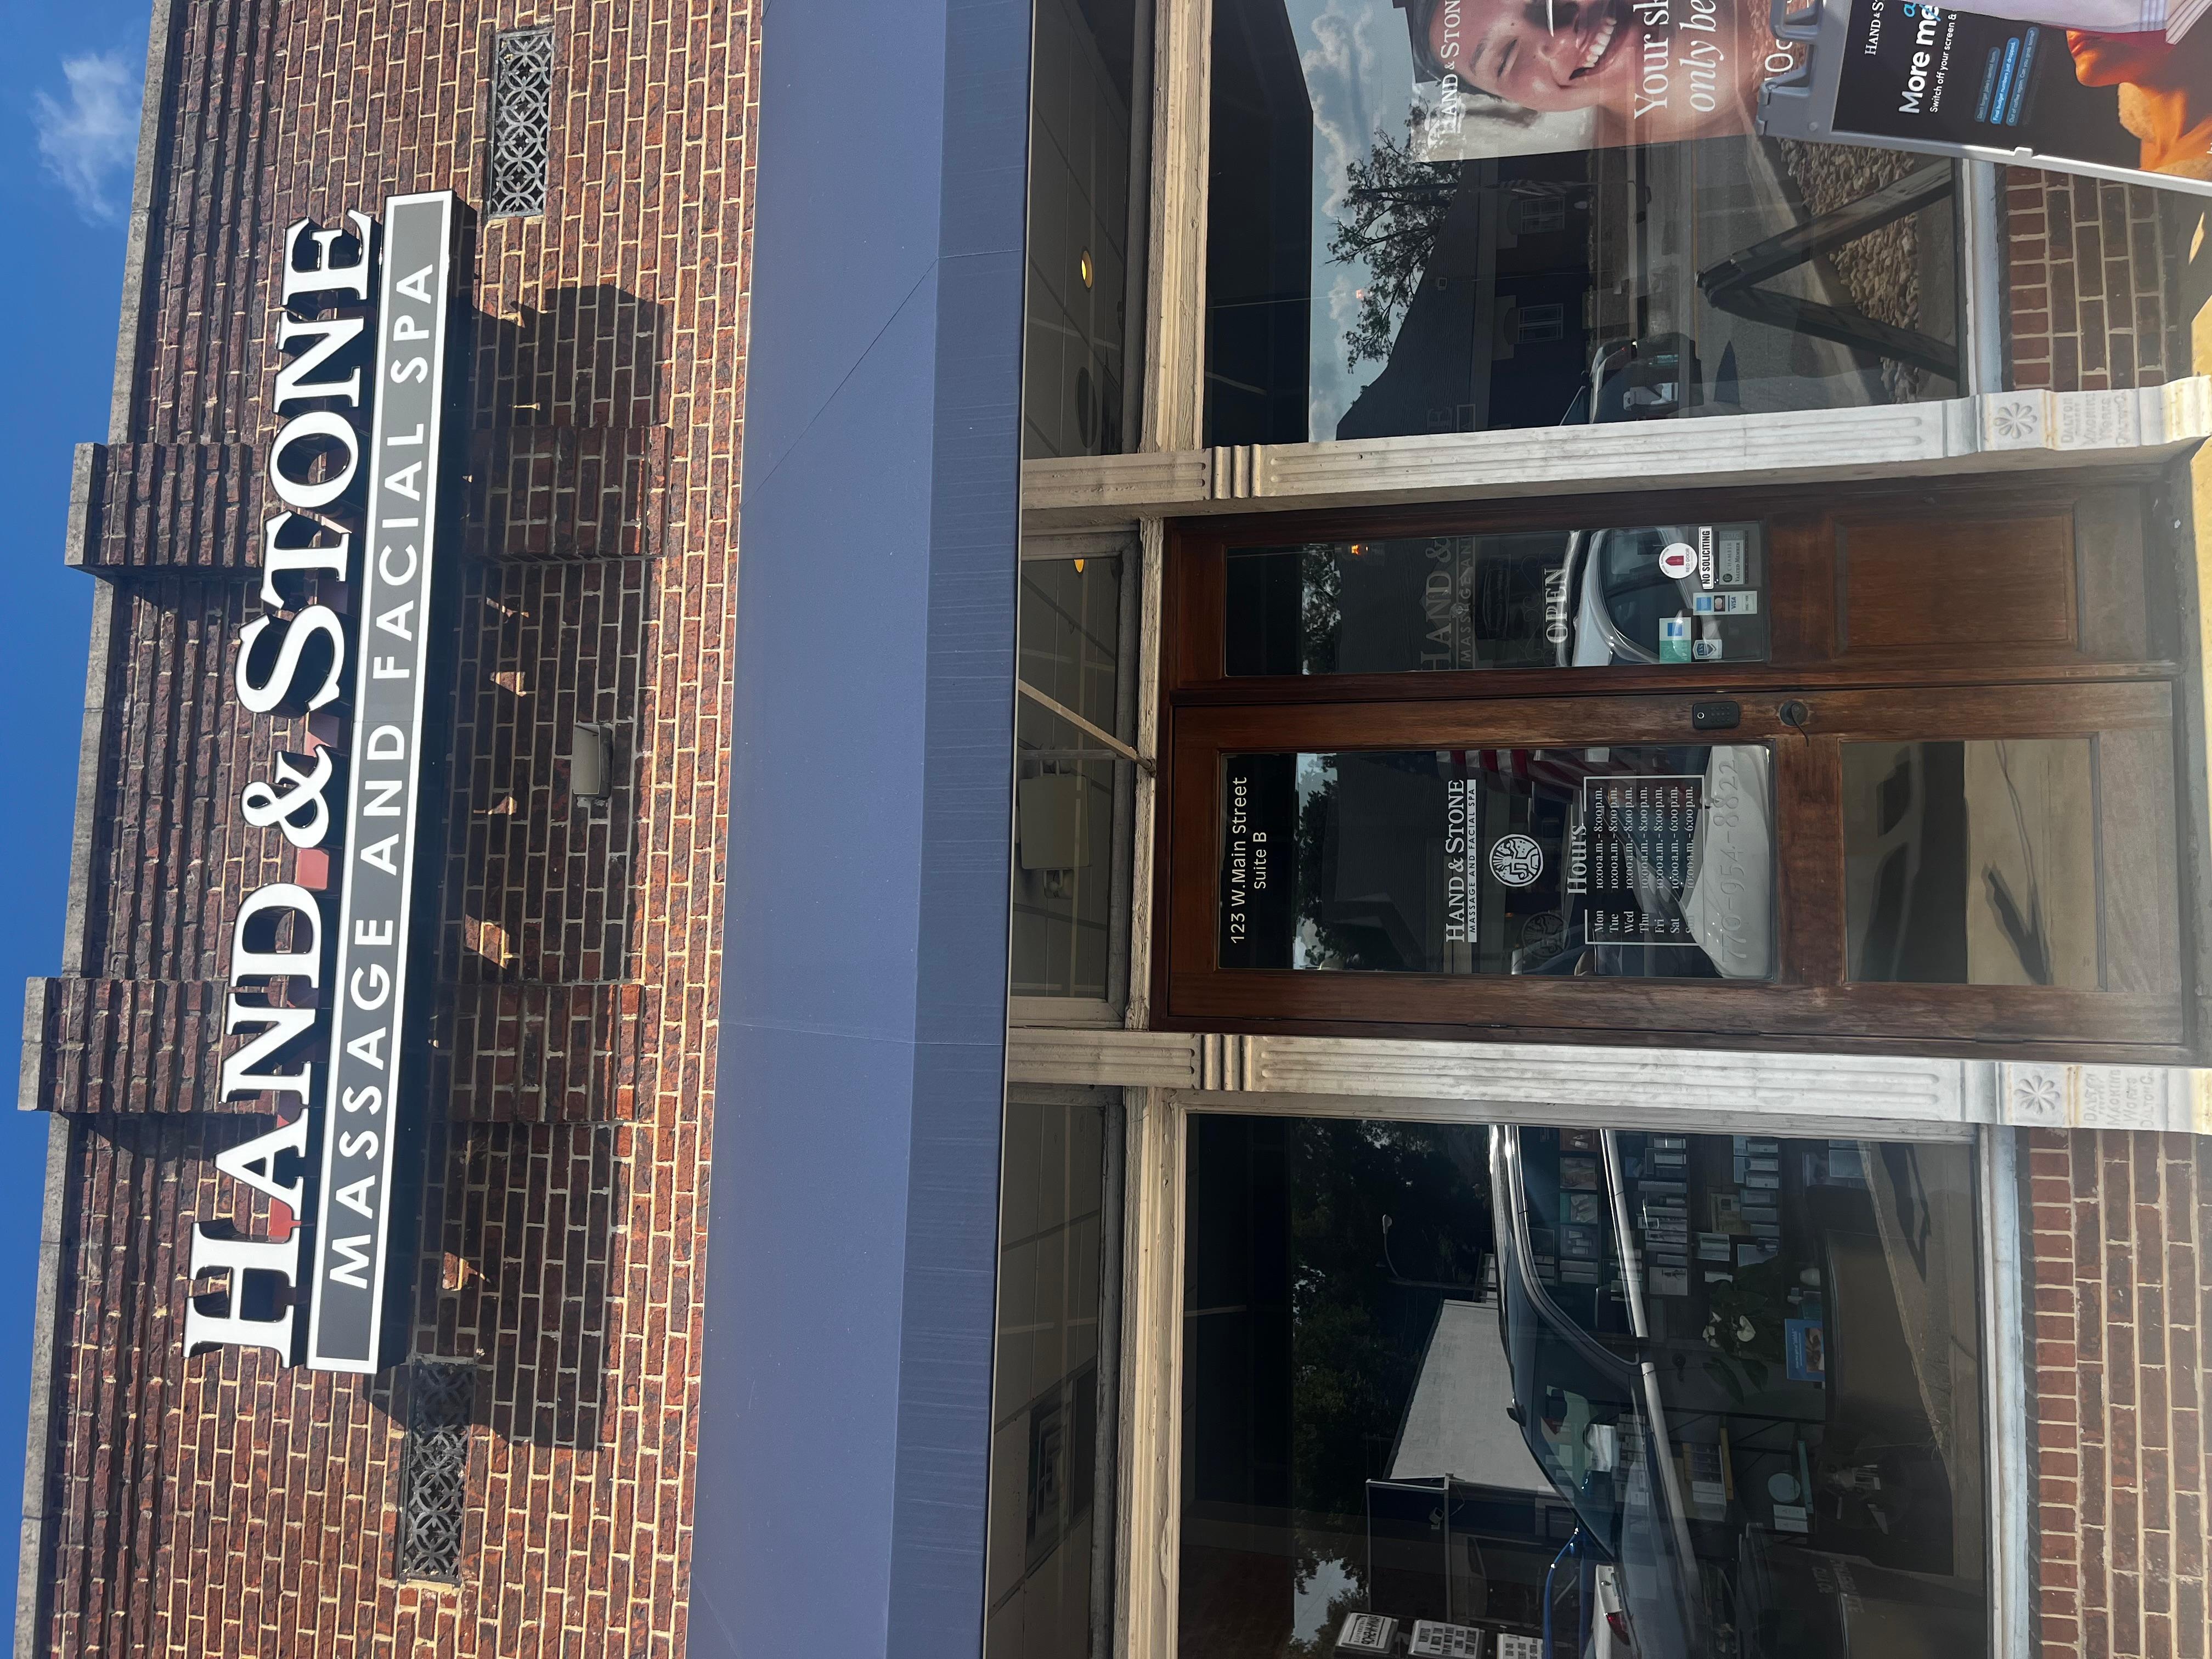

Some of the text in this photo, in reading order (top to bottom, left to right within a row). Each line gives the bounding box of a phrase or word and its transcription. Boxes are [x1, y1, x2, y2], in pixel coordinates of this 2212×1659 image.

[1872, 0, 1884, 11] S
[1864, 20, 1881, 55] HAND
[1944, 22, 1956, 50] screen
[2027, 30, 2035, 46] some?
[1444, 61, 1455, 70] &
[1679, 0, 1724, 112] only be
[1939, 52, 1949, 70] your
[1633, 34, 1669, 119] Your
[1899, 52, 1930, 114] More
[1937, 72, 1946, 84] off
[1995, 93, 2005, 109] budget
[2000, 72, 2008, 92] numbers
[2006, 42, 2016, 63] dropped.
[2016, 79, 2024, 93] again.
[1929, 86, 1943, 112] Switch
[2012, 94, 2021, 108] coffee
[1459, 538, 1472, 567] AN
[1702, 531, 1710, 584] NO SOLICITING
[1544, 568, 1567, 644] OPEN
[183, 207, 372, 1368] HAND & STONE
[329, 263, 434, 1289] MASSAGE AND FACIAL SPA
[1231, 777, 1248, 833] Street
[1468, 788, 1476, 806] SPA
[1252, 832, 1267, 889] Suite B
[1445, 780, 1465, 942] HAND & STONE
[1567, 825, 1587, 895] Hours
[1712, 759, 1747, 962] 770-954-8822
[1231, 912, 1245, 944] 123
[1594, 911, 1604, 932] Mon
[1610, 914, 1618, 932] Tue
[1624, 911, 1634, 933] Wed
[1639, 913, 1649, 933] Thu
[1655, 919, 1664, 933] Fri
[1670, 918, 1680, 933] Sat
